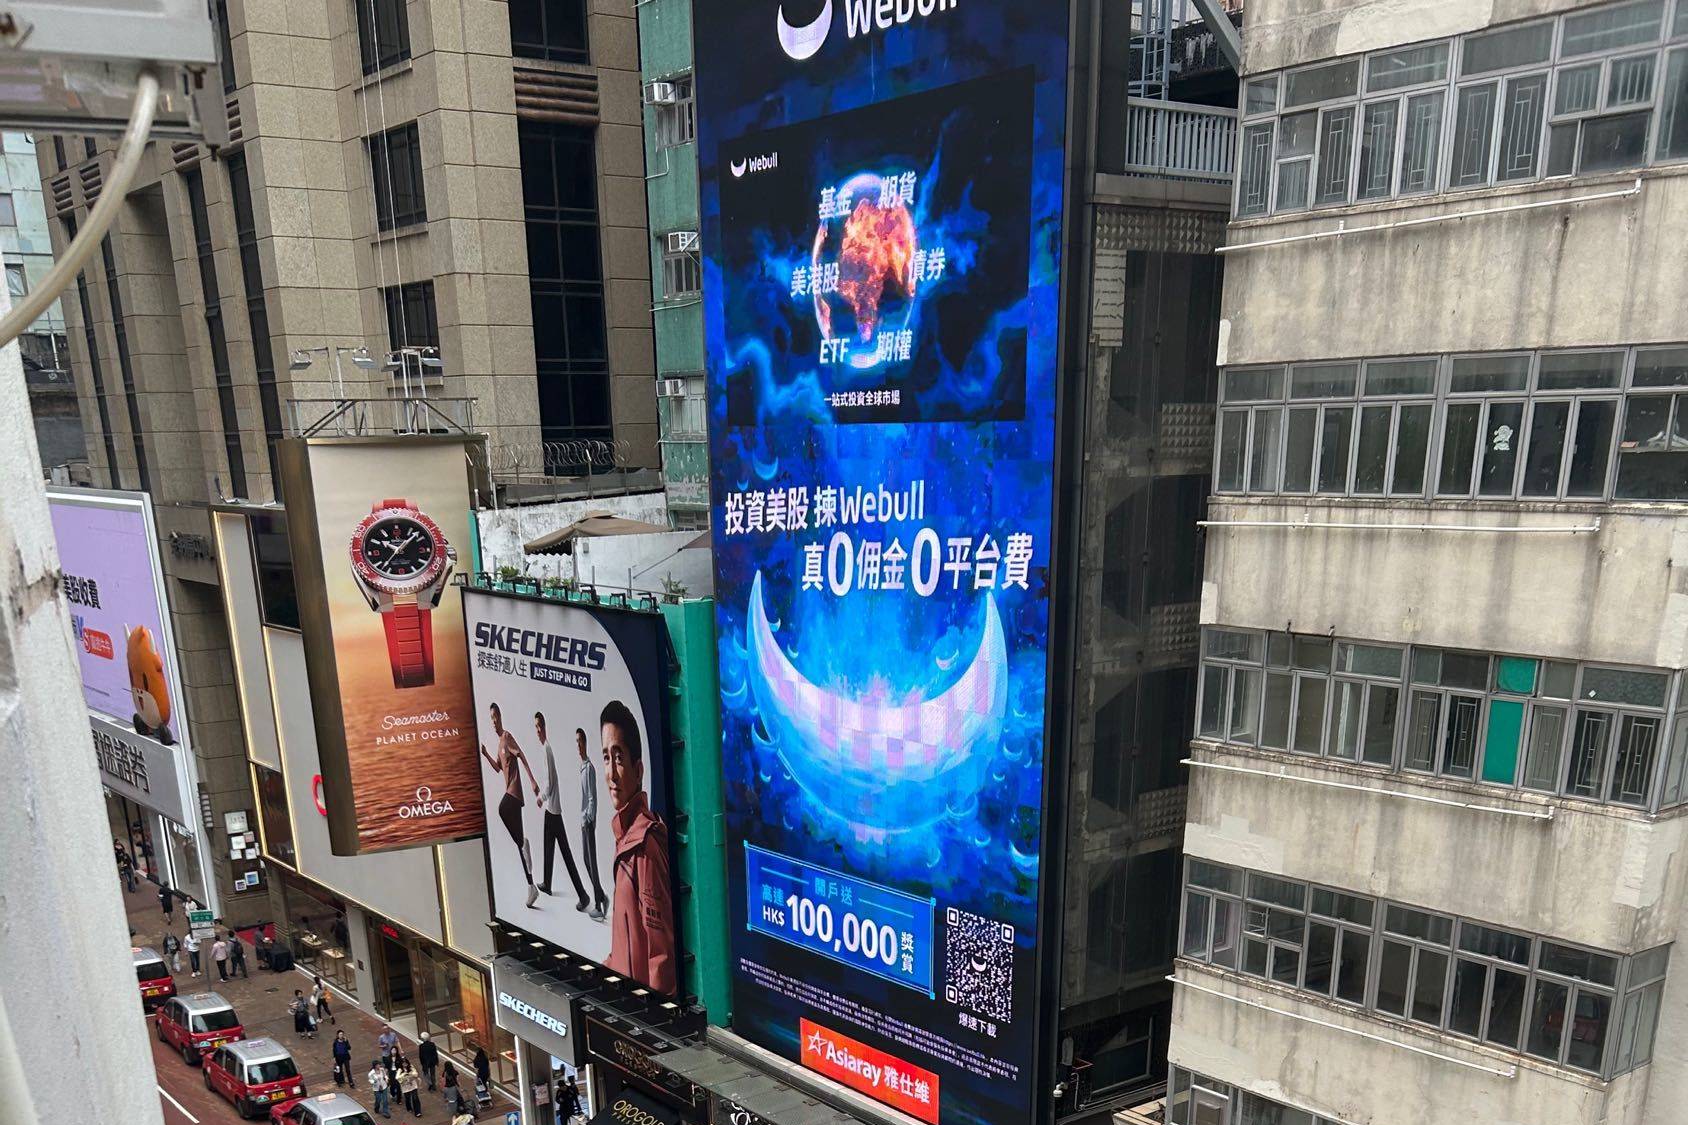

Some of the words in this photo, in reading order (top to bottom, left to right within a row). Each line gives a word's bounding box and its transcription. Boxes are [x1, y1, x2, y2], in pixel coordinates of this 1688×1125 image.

[845, 0, 957, 38] Webu
[749, 152, 778, 173] Webull
[818, 186, 854, 219] 基金
[877, 171, 917, 209] 期貨
[790, 262, 840, 298] 美港股
[819, 337, 850, 364] ETF
[876, 329, 913, 363] 期權
[824, 389, 900, 407] 一站式投資全球市場
[725, 486, 809, 535] 投資美股
[475, 622, 607, 670] SKECHERS
[477, 650, 528, 677] 探索舒適人生
[533, 667, 547, 678] JUST
[548, 670, 563, 681] STEP
[564, 673, 571, 683] IN
[578, 676, 588, 687] GO
[376, 732, 417, 745] PLANET
[421, 728, 460, 740] OCEAN
[382, 710, 450, 730] Seamaster
[399, 800, 454, 819] OMEGA
[499, 991, 567, 1037] SKECHERS
[825, 1041, 881, 1087] Asiaray
[884, 1065, 930, 1104] 雅仕維
